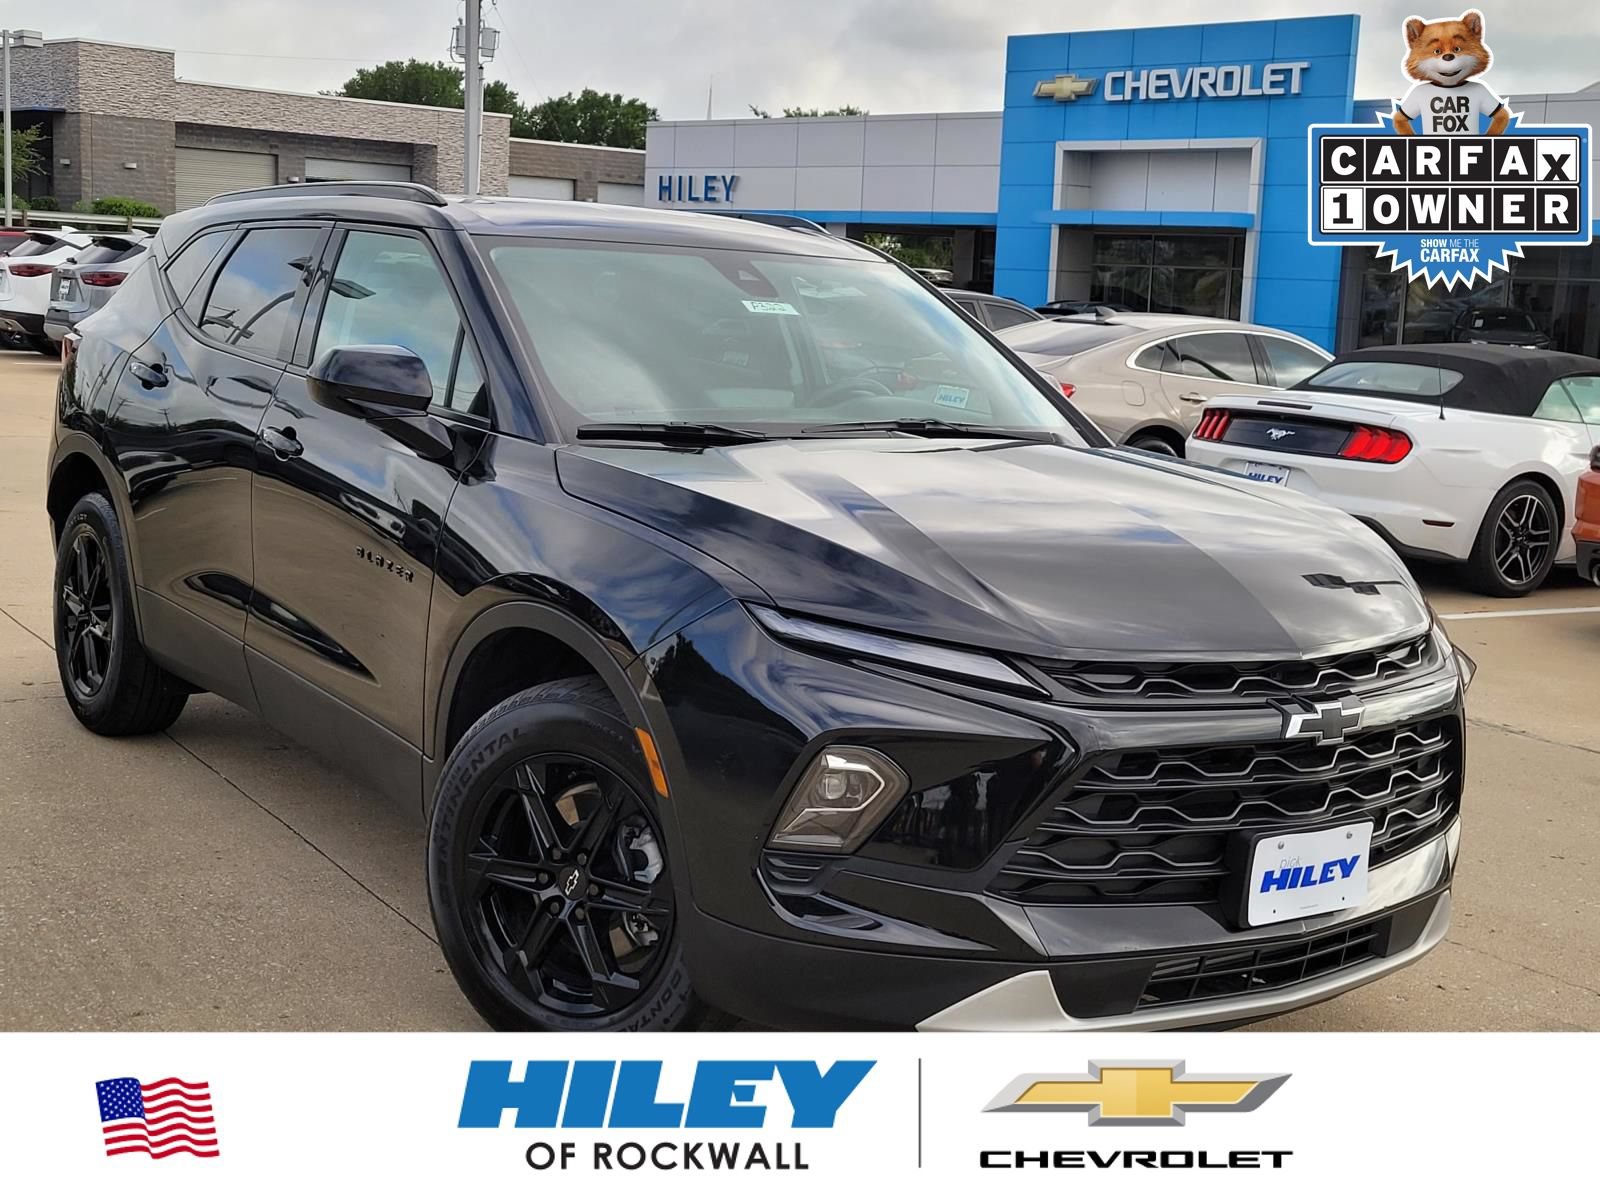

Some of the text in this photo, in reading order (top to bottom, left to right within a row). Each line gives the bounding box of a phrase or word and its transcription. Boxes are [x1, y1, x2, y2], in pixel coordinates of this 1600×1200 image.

[1104, 62, 1310, 101] CHEVROLET
[658, 175, 738, 202] HILEY
[356, 545, 414, 583] BLAZER
[1260, 854, 1361, 894] HILEY
